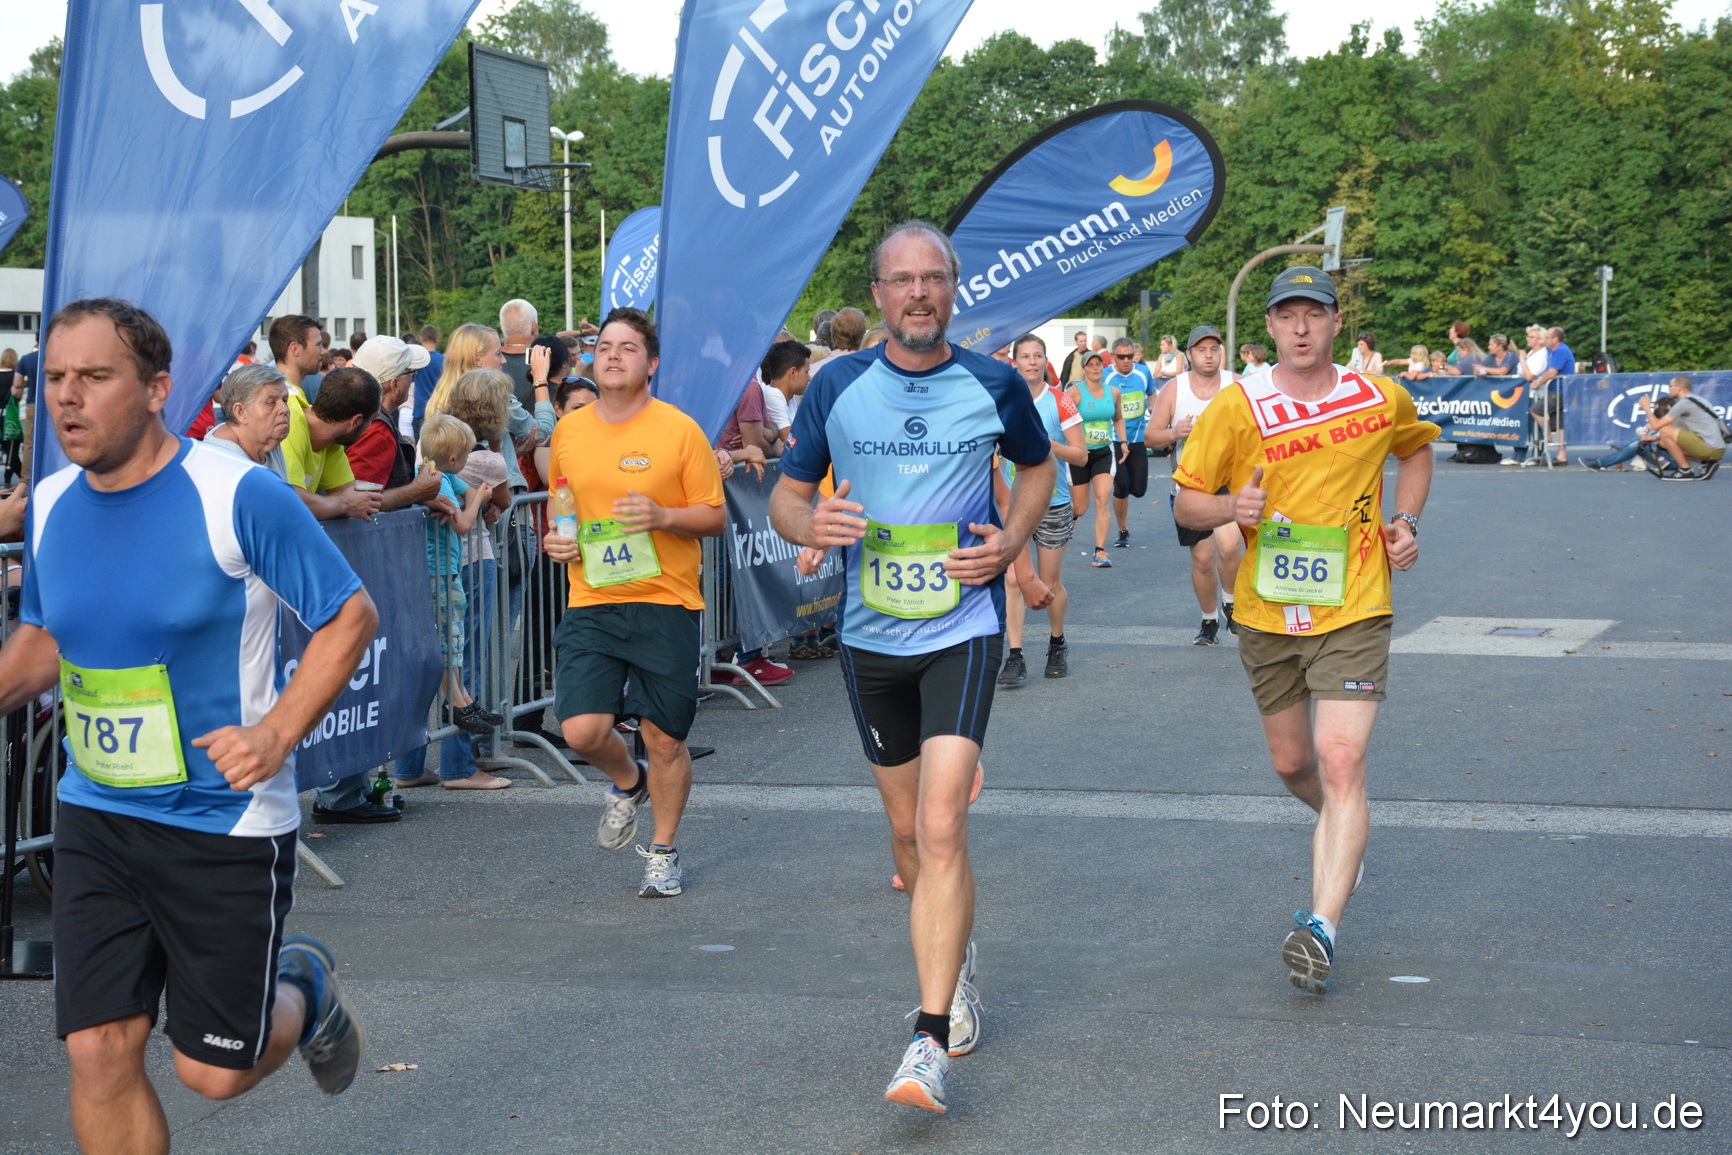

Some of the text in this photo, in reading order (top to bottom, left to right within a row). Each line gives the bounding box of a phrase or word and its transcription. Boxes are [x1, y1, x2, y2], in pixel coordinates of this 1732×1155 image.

[753, 0, 880, 160] Fisc
[819, 0, 923, 156] AUTOMO
[1056, 188, 1203, 275] Druck und Medien
[952, 202, 1131, 316] ischmann
[1123, 402, 1140, 412] 523
[1411, 396, 1492, 416] rischmann
[853, 440, 978, 456] SCHABMÜLLER
[1264, 413, 1393, 464] MAX BÖGL
[897, 464, 929, 475] TEAM
[602, 543, 633, 566] 44
[1273, 554, 1329, 583] 856
[869, 557, 949, 593] 1333
[76, 712, 144, 754] 787
[203, 1033, 245, 1050] JAKO
